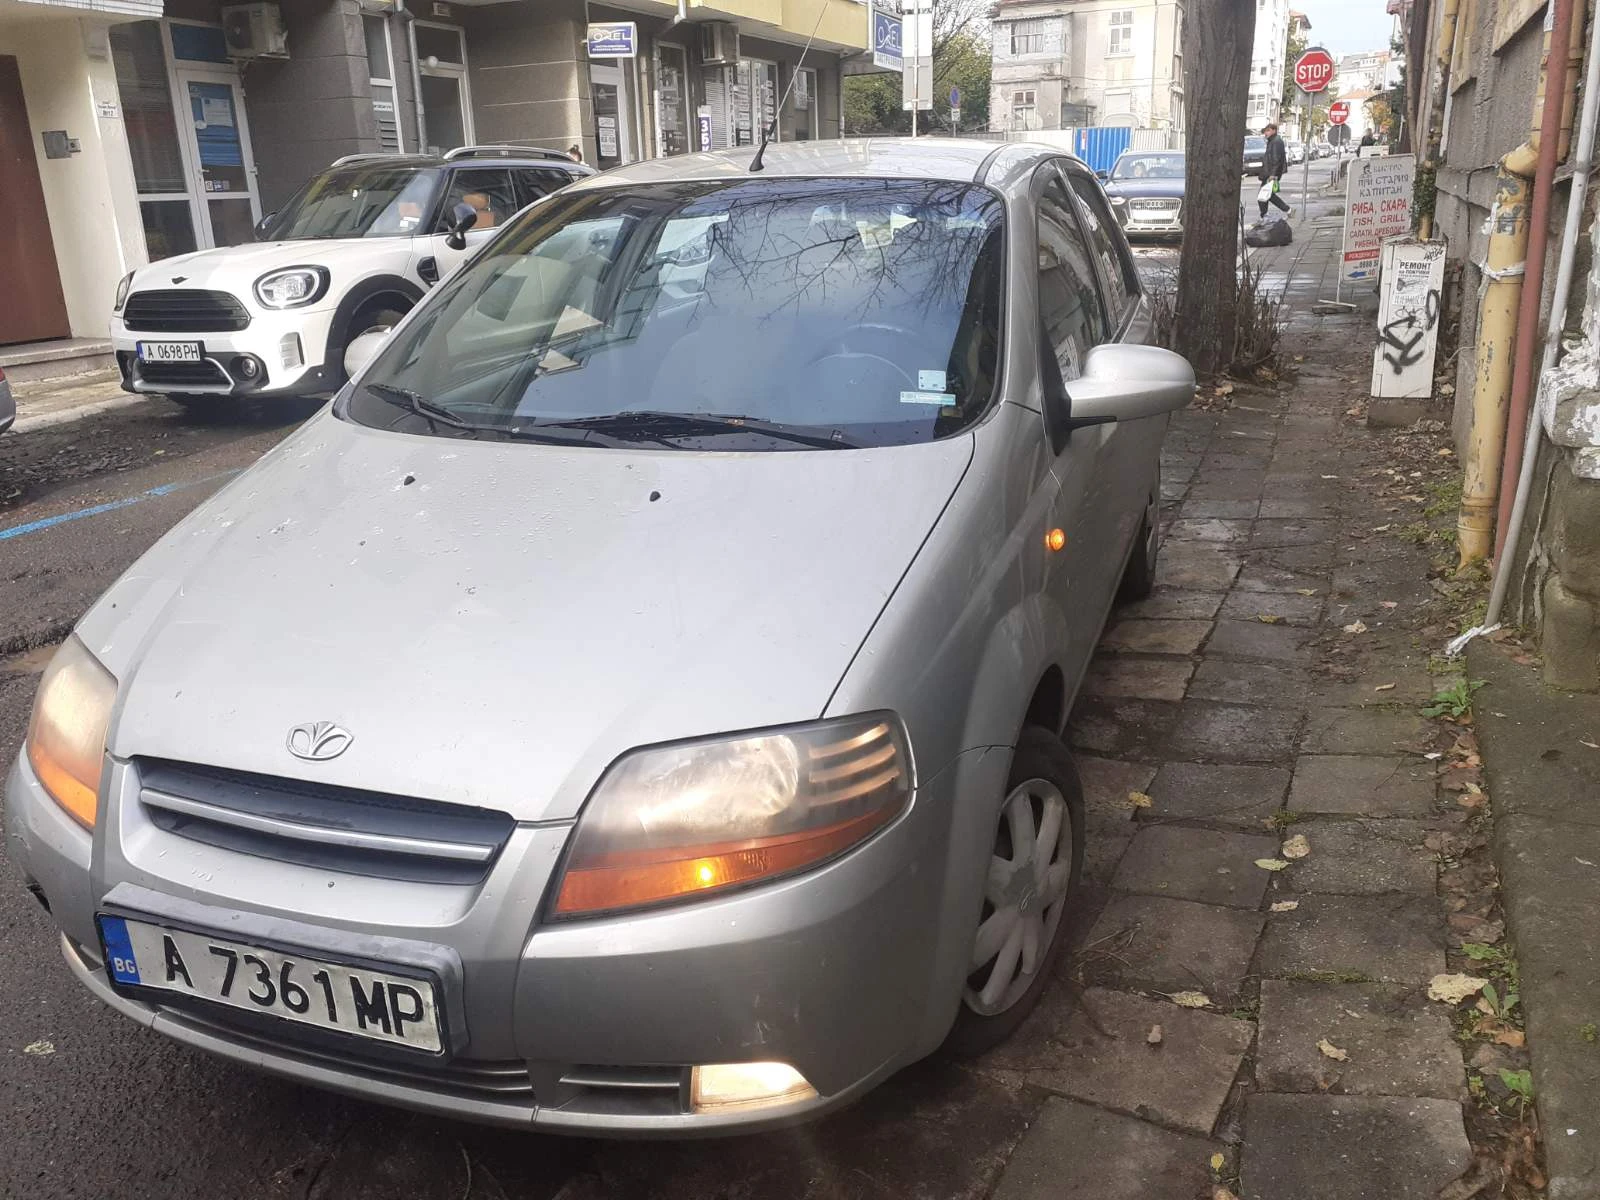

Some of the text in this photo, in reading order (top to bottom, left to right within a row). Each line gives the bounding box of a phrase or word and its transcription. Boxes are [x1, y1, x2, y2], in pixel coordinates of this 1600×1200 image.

[1298, 63, 1330, 80] STOP
[1351, 199, 1407, 215] РИБА, СКАРА
[1353, 213, 1405, 226] FISH, GRILL
[1399, 261, 1431, 270] РЕМОНТ
[147, 344, 199, 359] A 0698 PH
[113, 956, 136, 976] BG
[163, 933, 424, 1038] A 7361 MP
